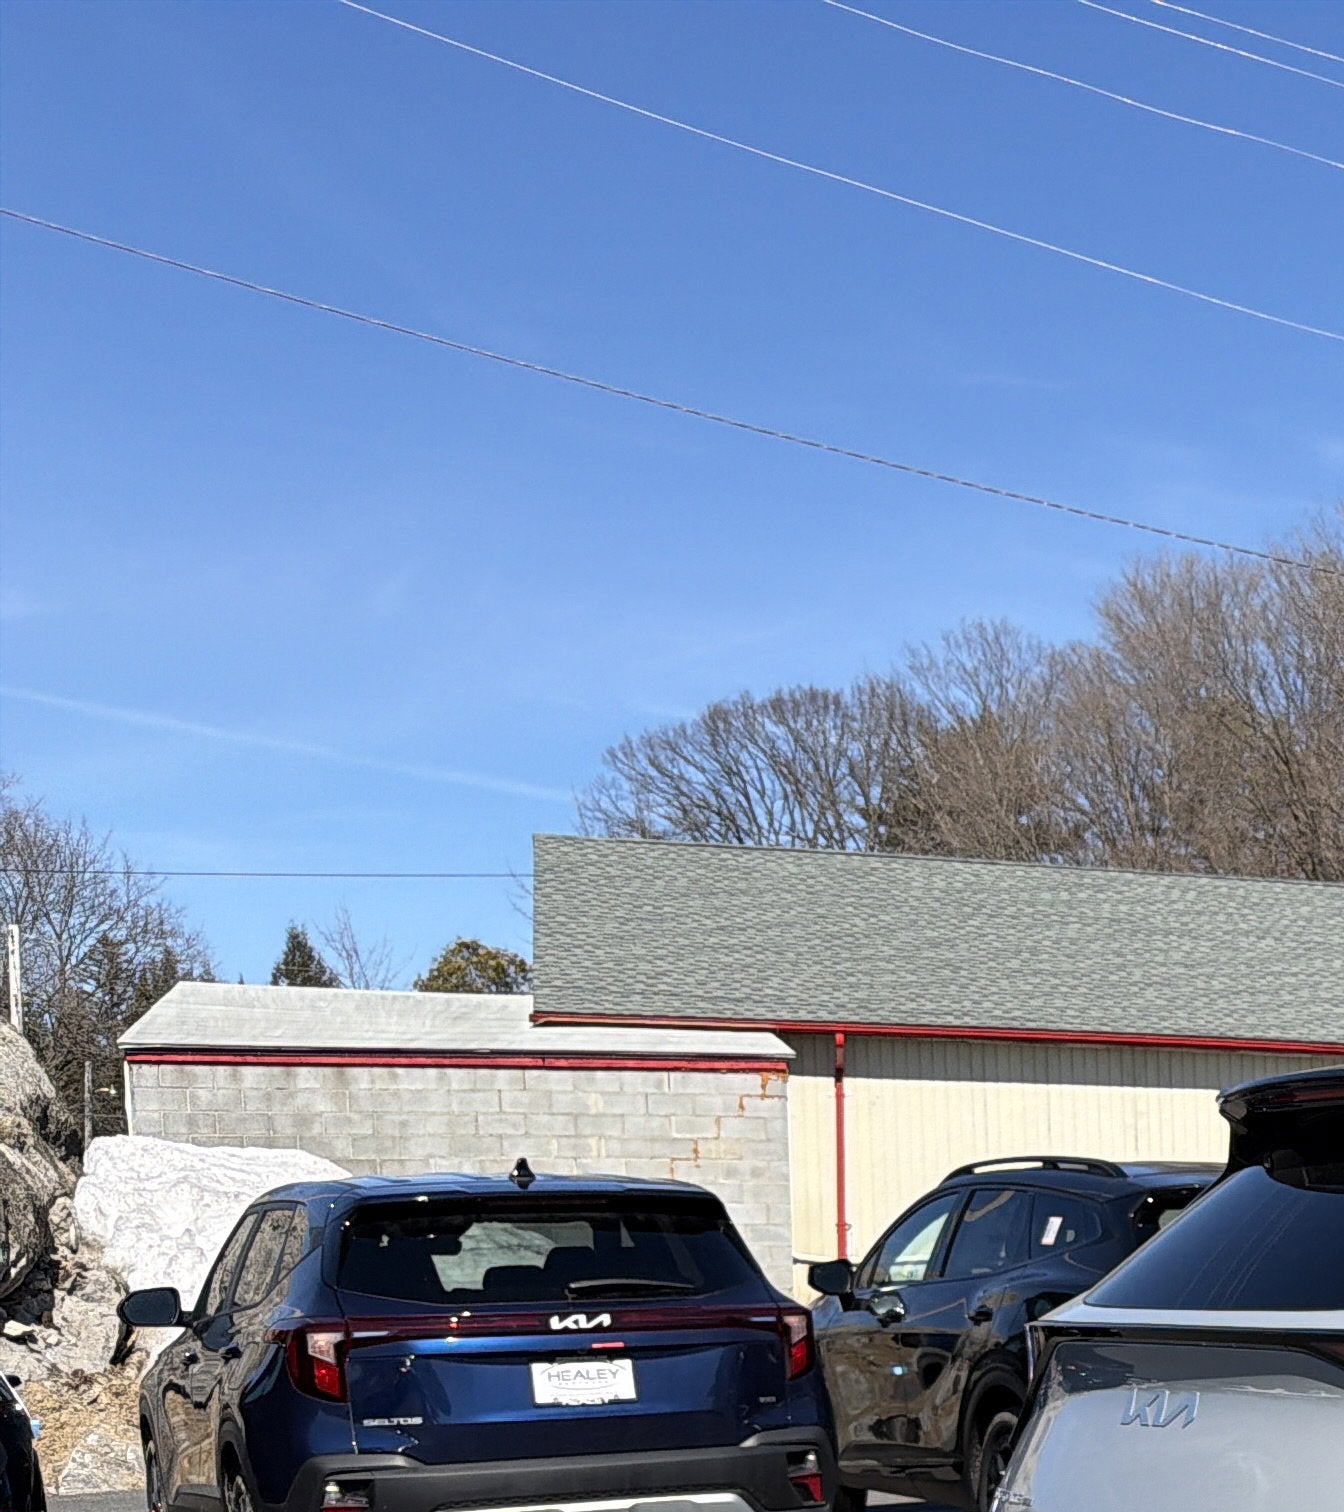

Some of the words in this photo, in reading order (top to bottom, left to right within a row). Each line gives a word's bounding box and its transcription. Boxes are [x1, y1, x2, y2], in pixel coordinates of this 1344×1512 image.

[549, 1313, 612, 1330] KIA
[547, 1368, 620, 1382] HEALEY
[1120, 1386, 1201, 1430] KIA
